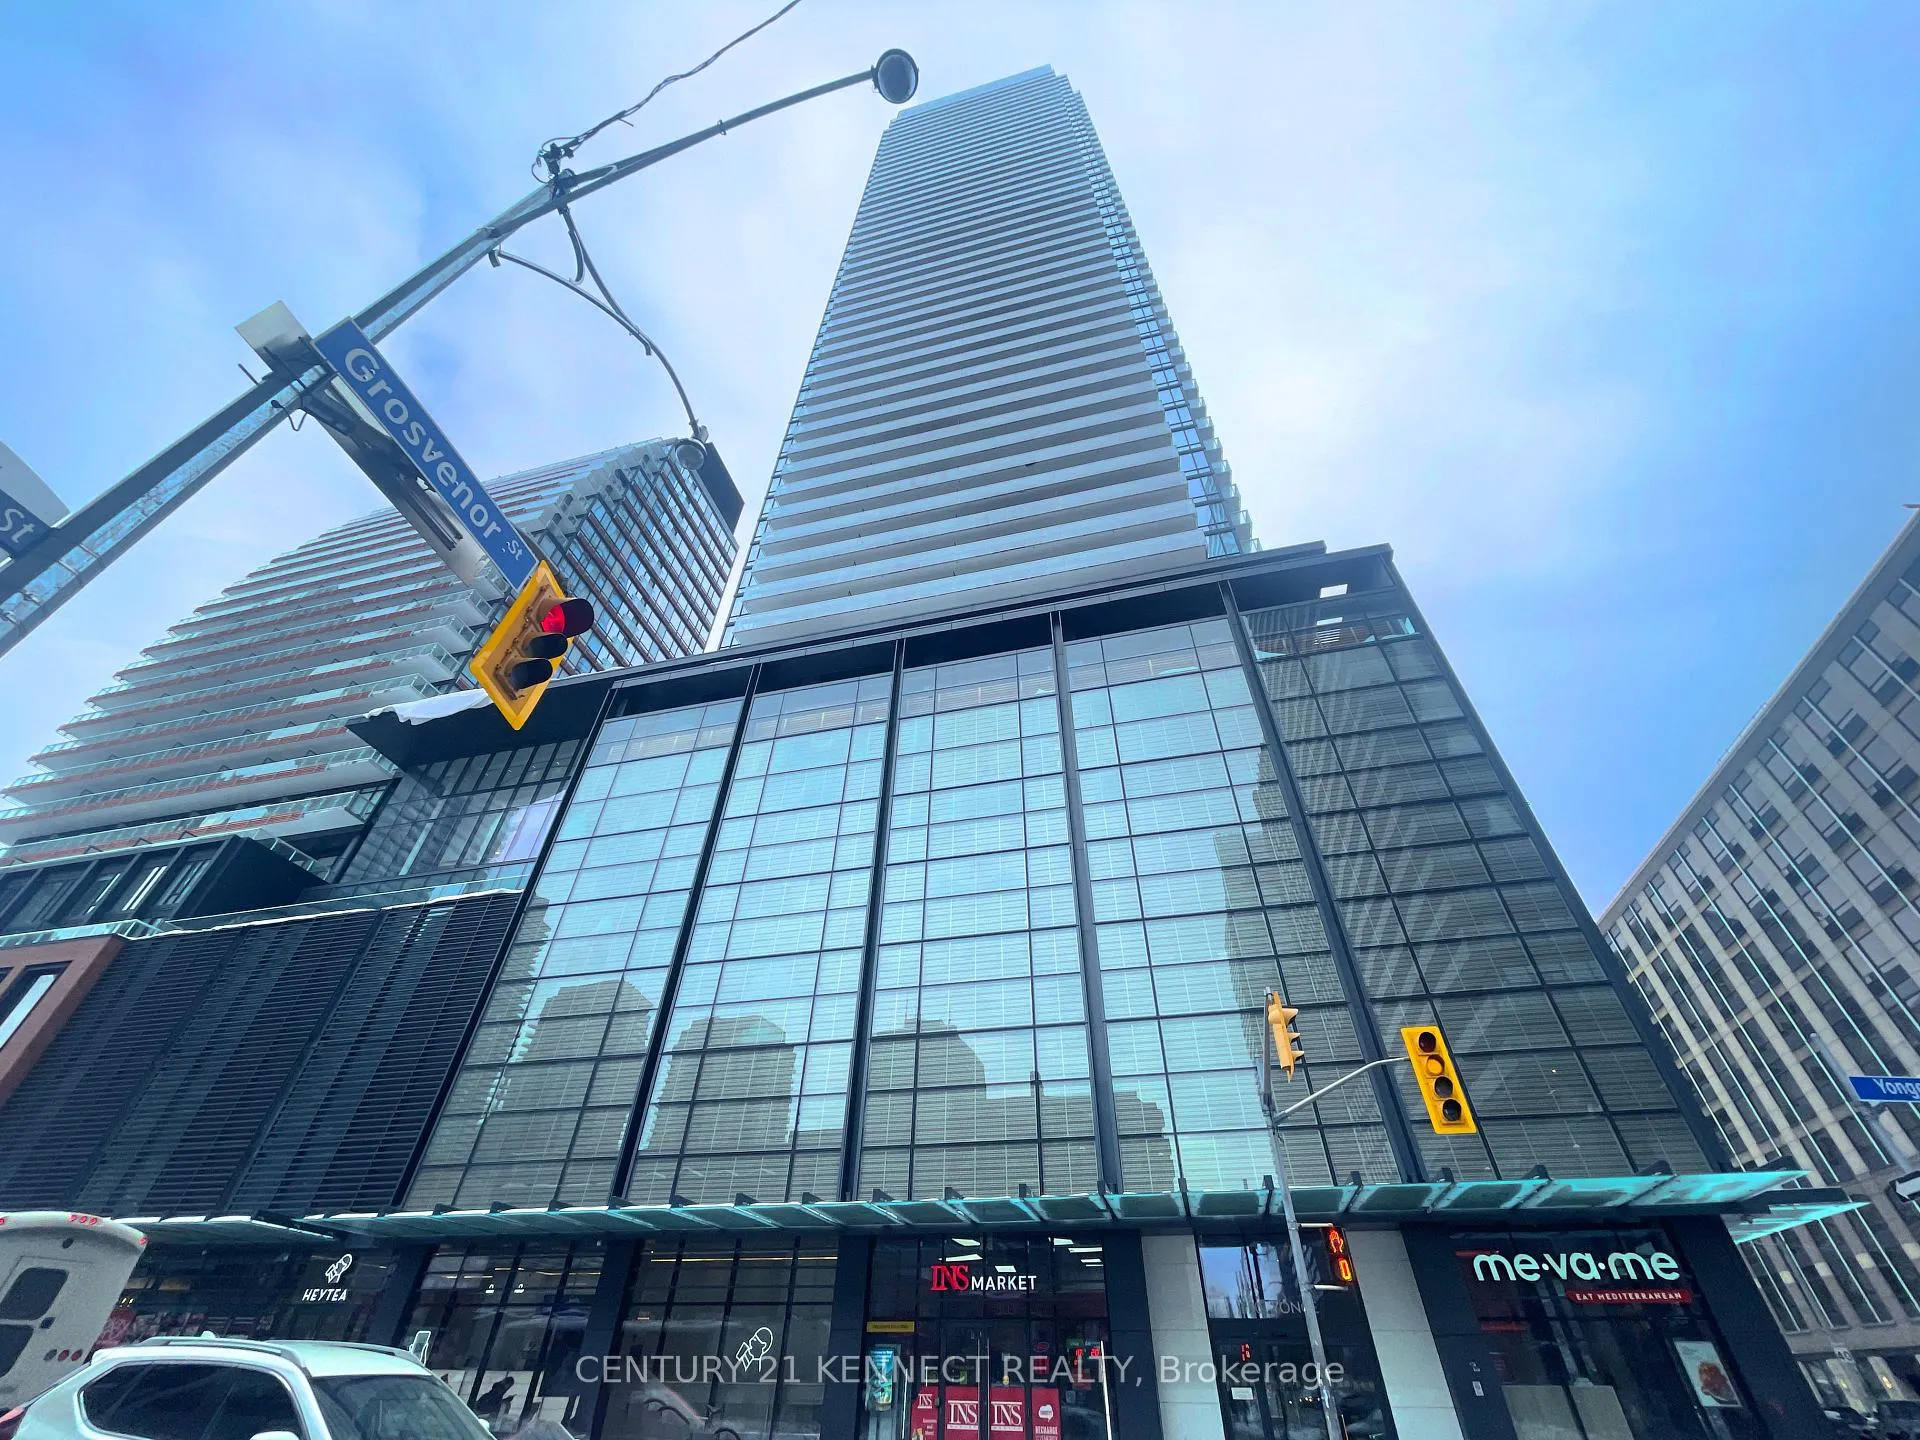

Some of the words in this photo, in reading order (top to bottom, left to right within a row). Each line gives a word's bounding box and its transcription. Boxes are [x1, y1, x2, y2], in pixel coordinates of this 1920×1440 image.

[345, 348, 501, 538] Grosvenor
[507, 540, 523, 561] St
[0, 508, 35, 543] St
[929, 1265, 969, 1291] INS
[971, 1275, 1037, 1291] MARKET
[301, 1288, 348, 1301] HEYTEA
[1575, 1293, 1594, 1301] EAT
[1597, 1292, 1682, 1301] MEDITERRANEAN
[948, 1401, 978, 1425] INS
[991, 1402, 1022, 1426] INS
